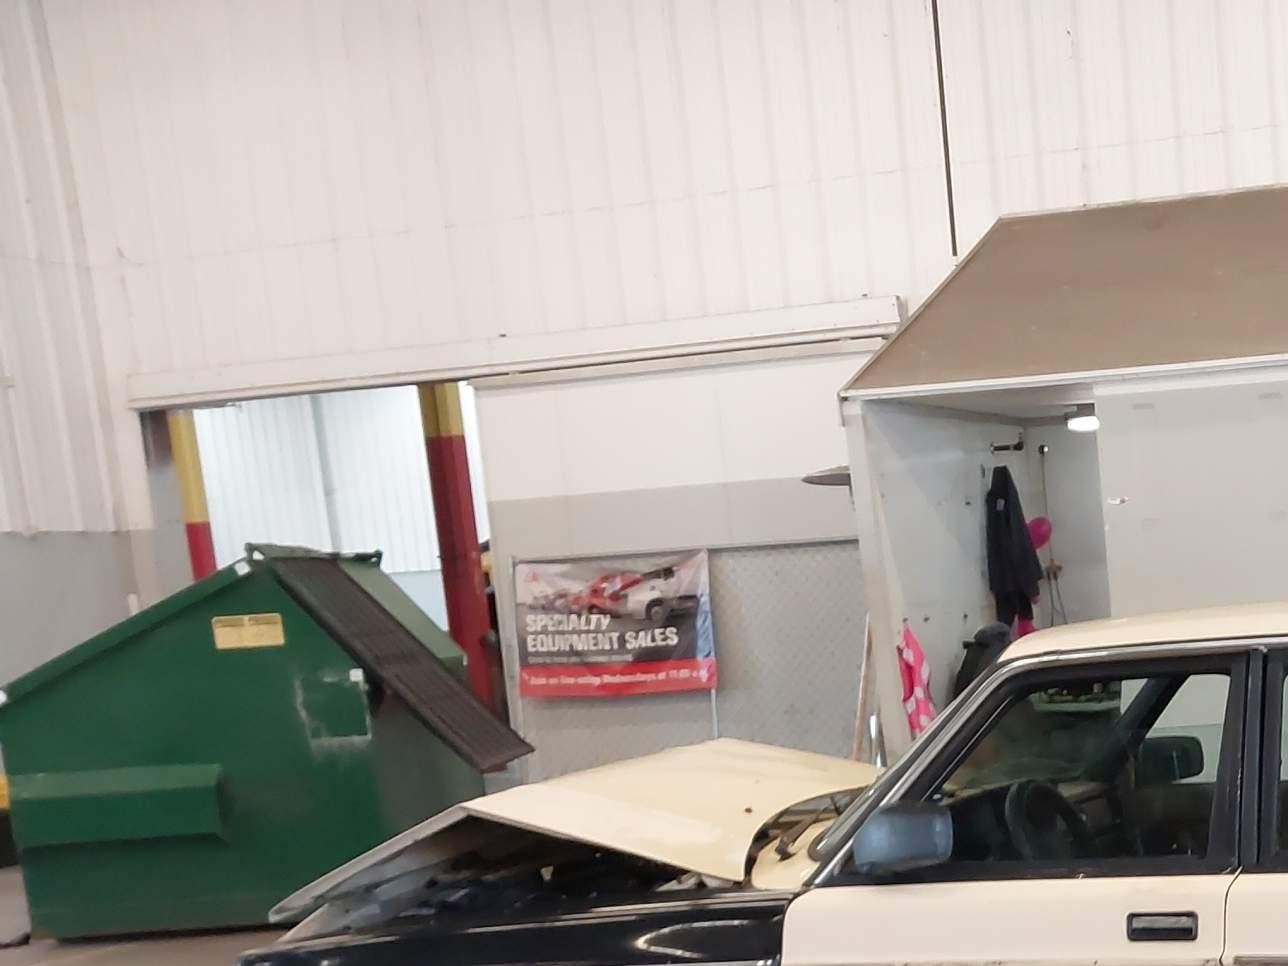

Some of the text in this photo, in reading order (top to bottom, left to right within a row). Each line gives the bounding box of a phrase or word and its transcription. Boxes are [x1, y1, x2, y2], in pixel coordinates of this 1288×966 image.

[526, 614, 611, 632] SPECIALTY
[527, 627, 679, 652] EQUIPMENT SALES
